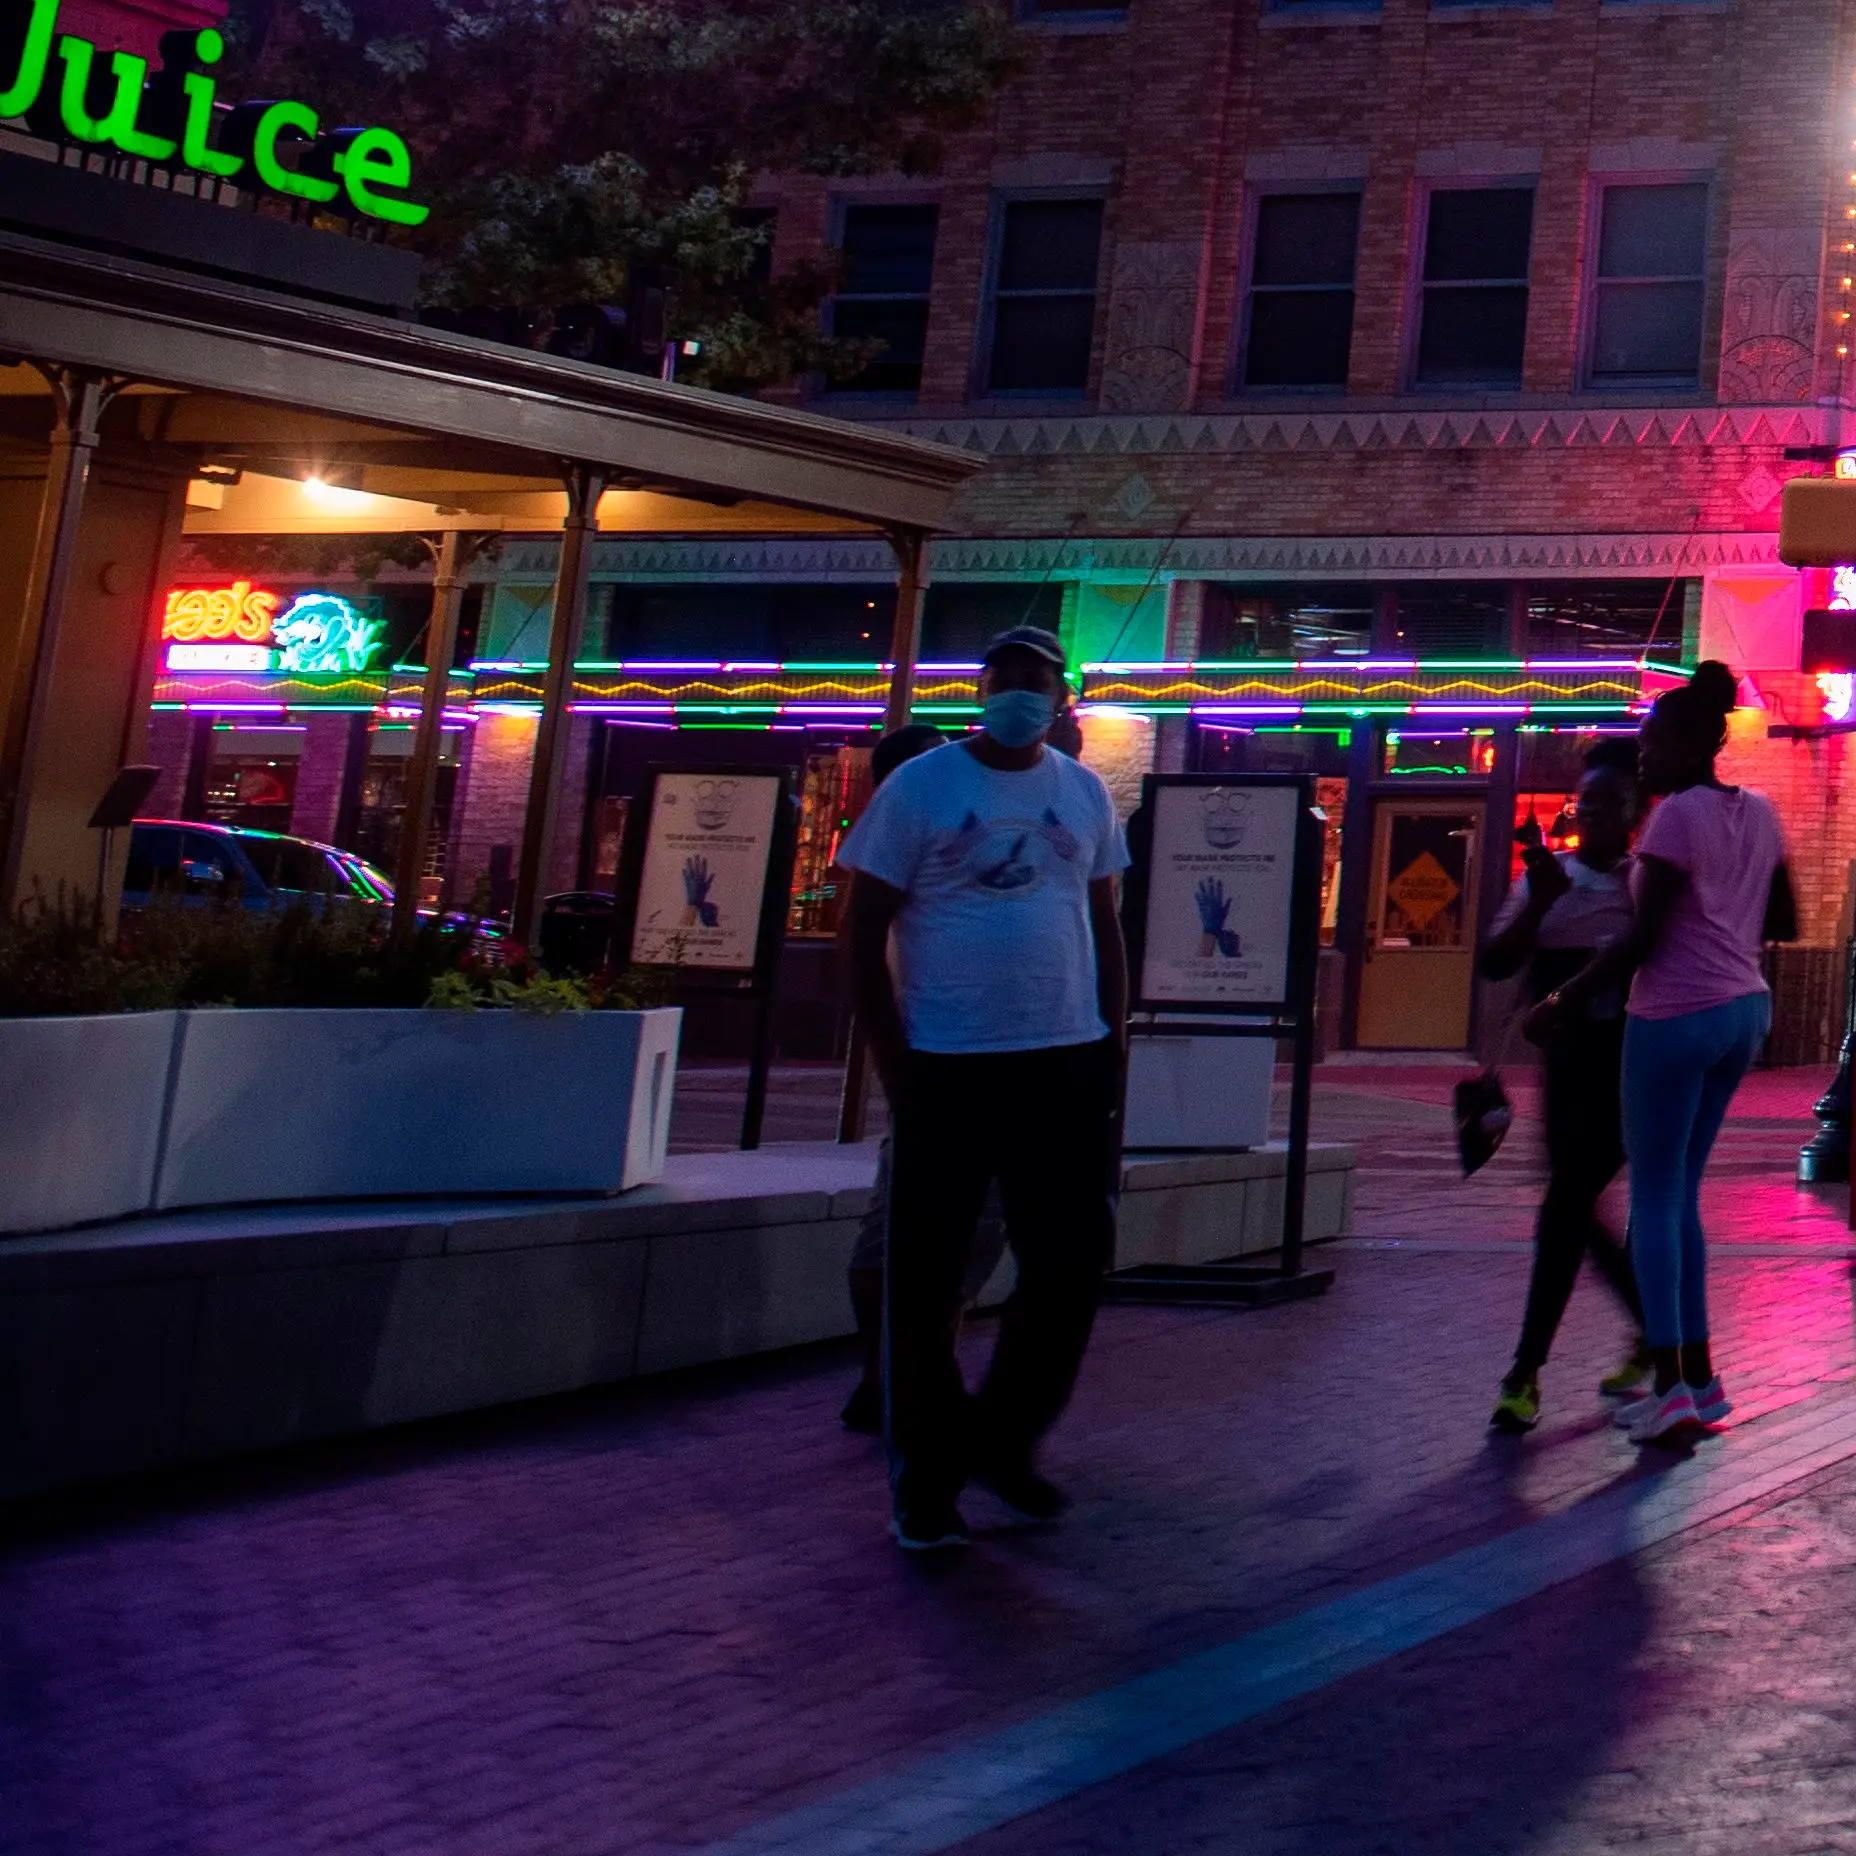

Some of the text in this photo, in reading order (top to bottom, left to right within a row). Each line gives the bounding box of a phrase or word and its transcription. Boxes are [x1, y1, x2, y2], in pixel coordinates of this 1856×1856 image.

[1171, 853, 1193, 862] YOUR
[1194, 853, 1218, 862] MASK
[1220, 853, 1262, 863] PROTECTS
